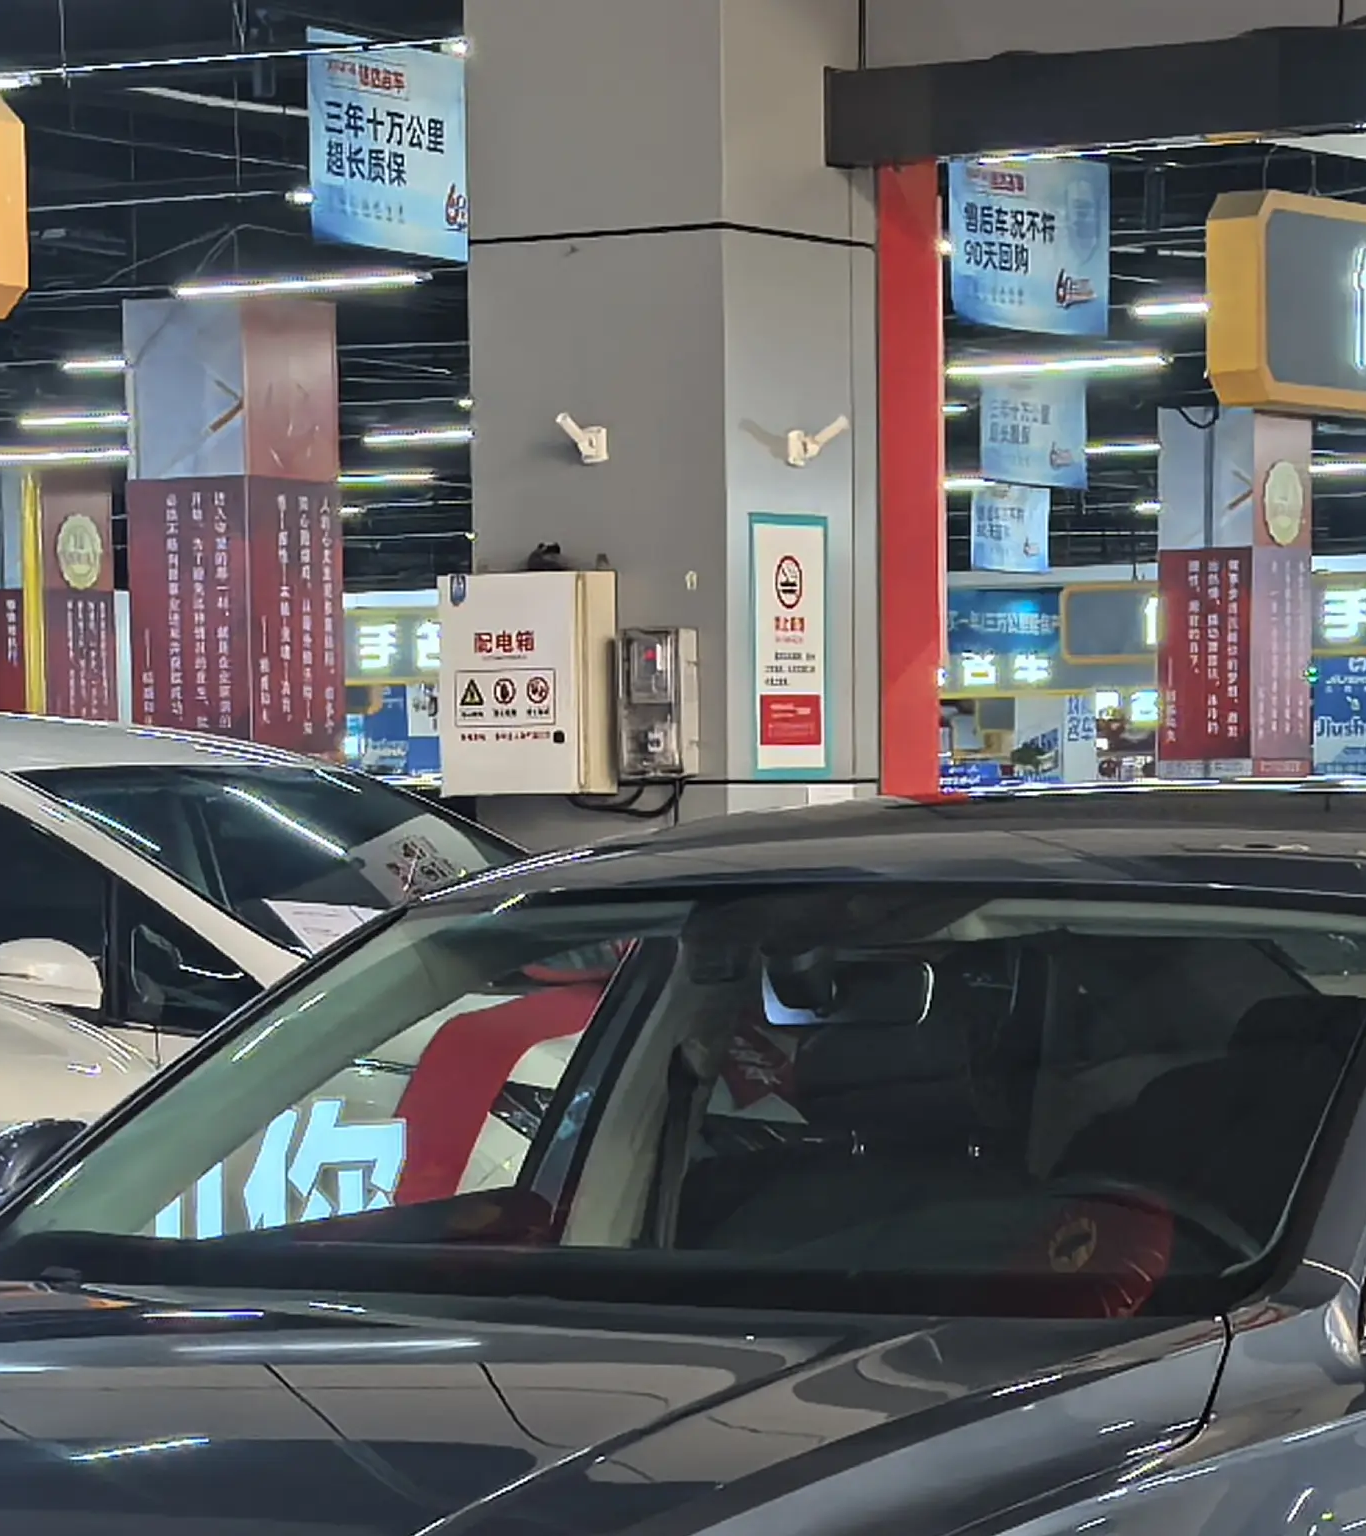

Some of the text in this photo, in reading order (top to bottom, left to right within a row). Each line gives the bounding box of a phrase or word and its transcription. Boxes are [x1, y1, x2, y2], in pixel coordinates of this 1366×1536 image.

[325, 101, 444, 154] 三年十万公里
[326, 140, 407, 187] 超长质保
[474, 630, 535, 654] 配电箱
